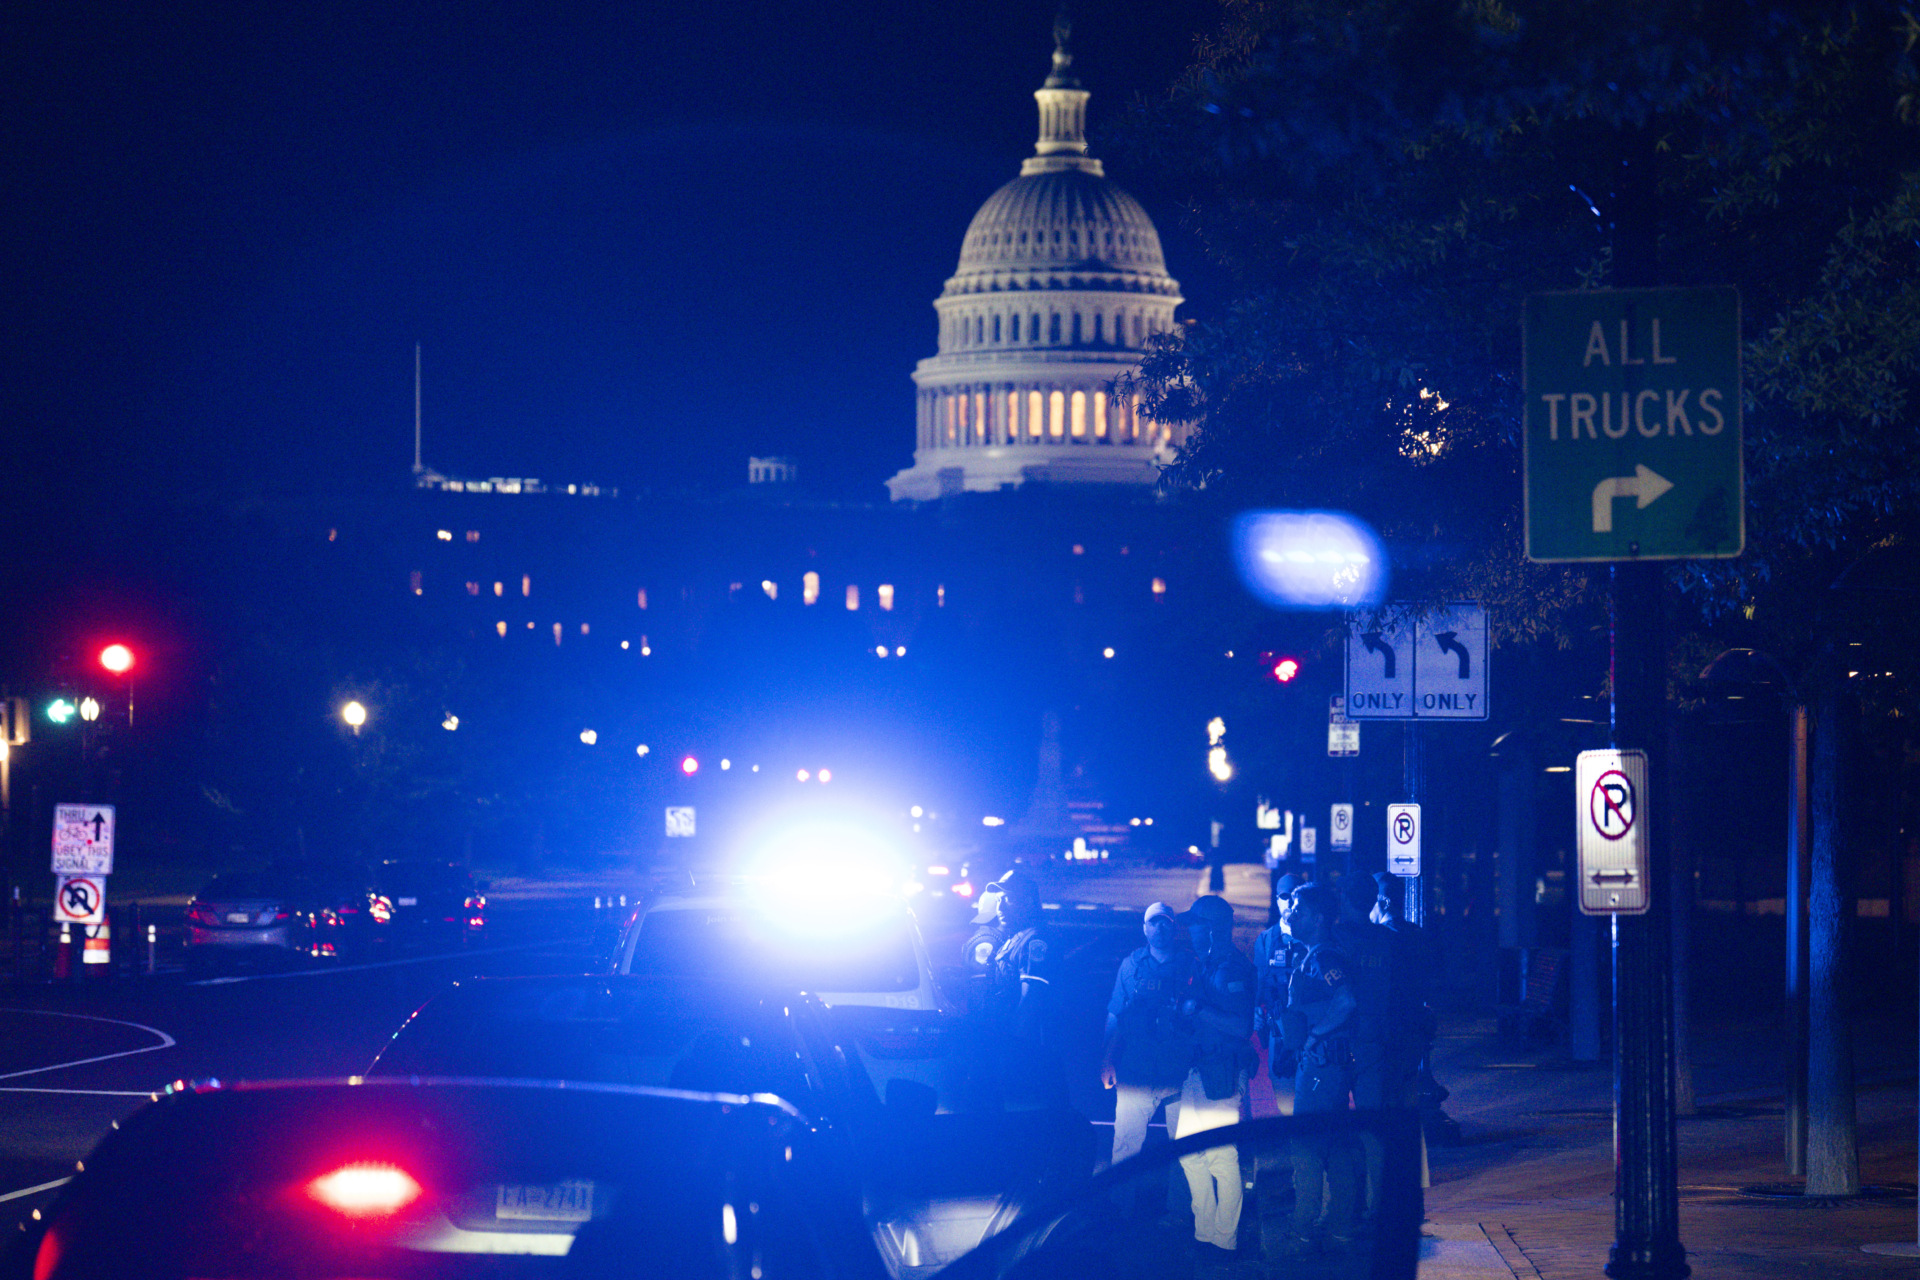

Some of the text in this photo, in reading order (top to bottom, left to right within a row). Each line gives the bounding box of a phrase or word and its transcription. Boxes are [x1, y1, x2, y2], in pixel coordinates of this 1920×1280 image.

[1583, 318, 1677, 367] ALL
[1541, 388, 1724, 440] TRUCKS
[1353, 692, 1404, 710] ONLY
[1423, 693, 1477, 710] ONLY
[59, 809, 86, 822] THRU
[87, 845, 109, 857] THIS
[56, 858, 90, 870] SIGNAL
[1139, 979, 1161, 990] FBI
